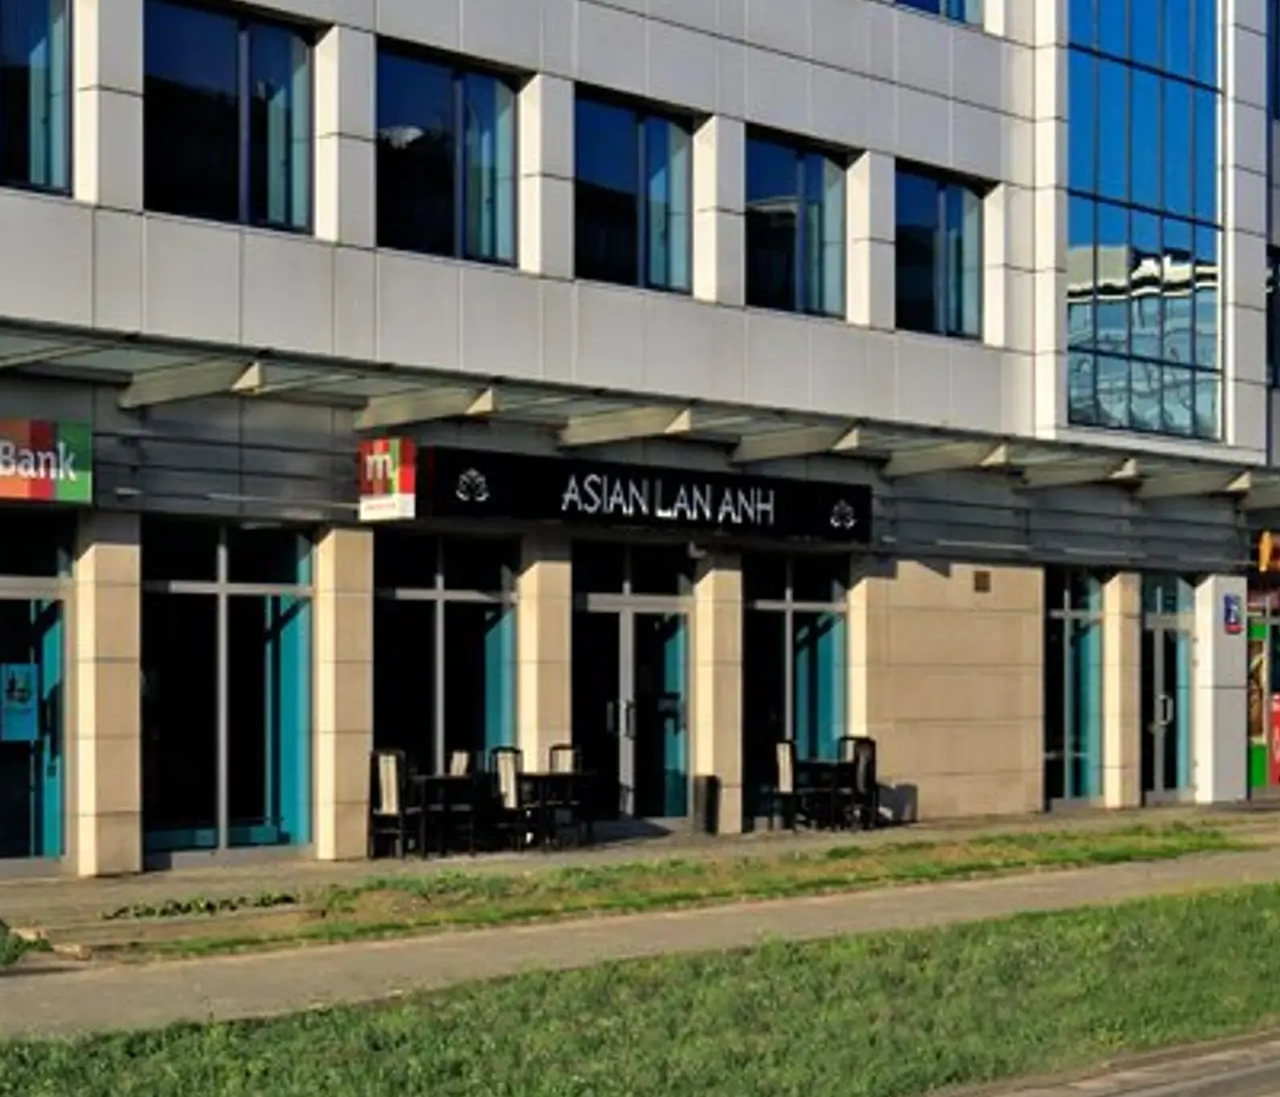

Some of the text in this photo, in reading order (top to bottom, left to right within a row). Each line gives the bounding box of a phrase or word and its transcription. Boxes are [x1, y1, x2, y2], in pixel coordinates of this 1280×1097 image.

[561, 474, 775, 525] ASIAN LAN ANH
